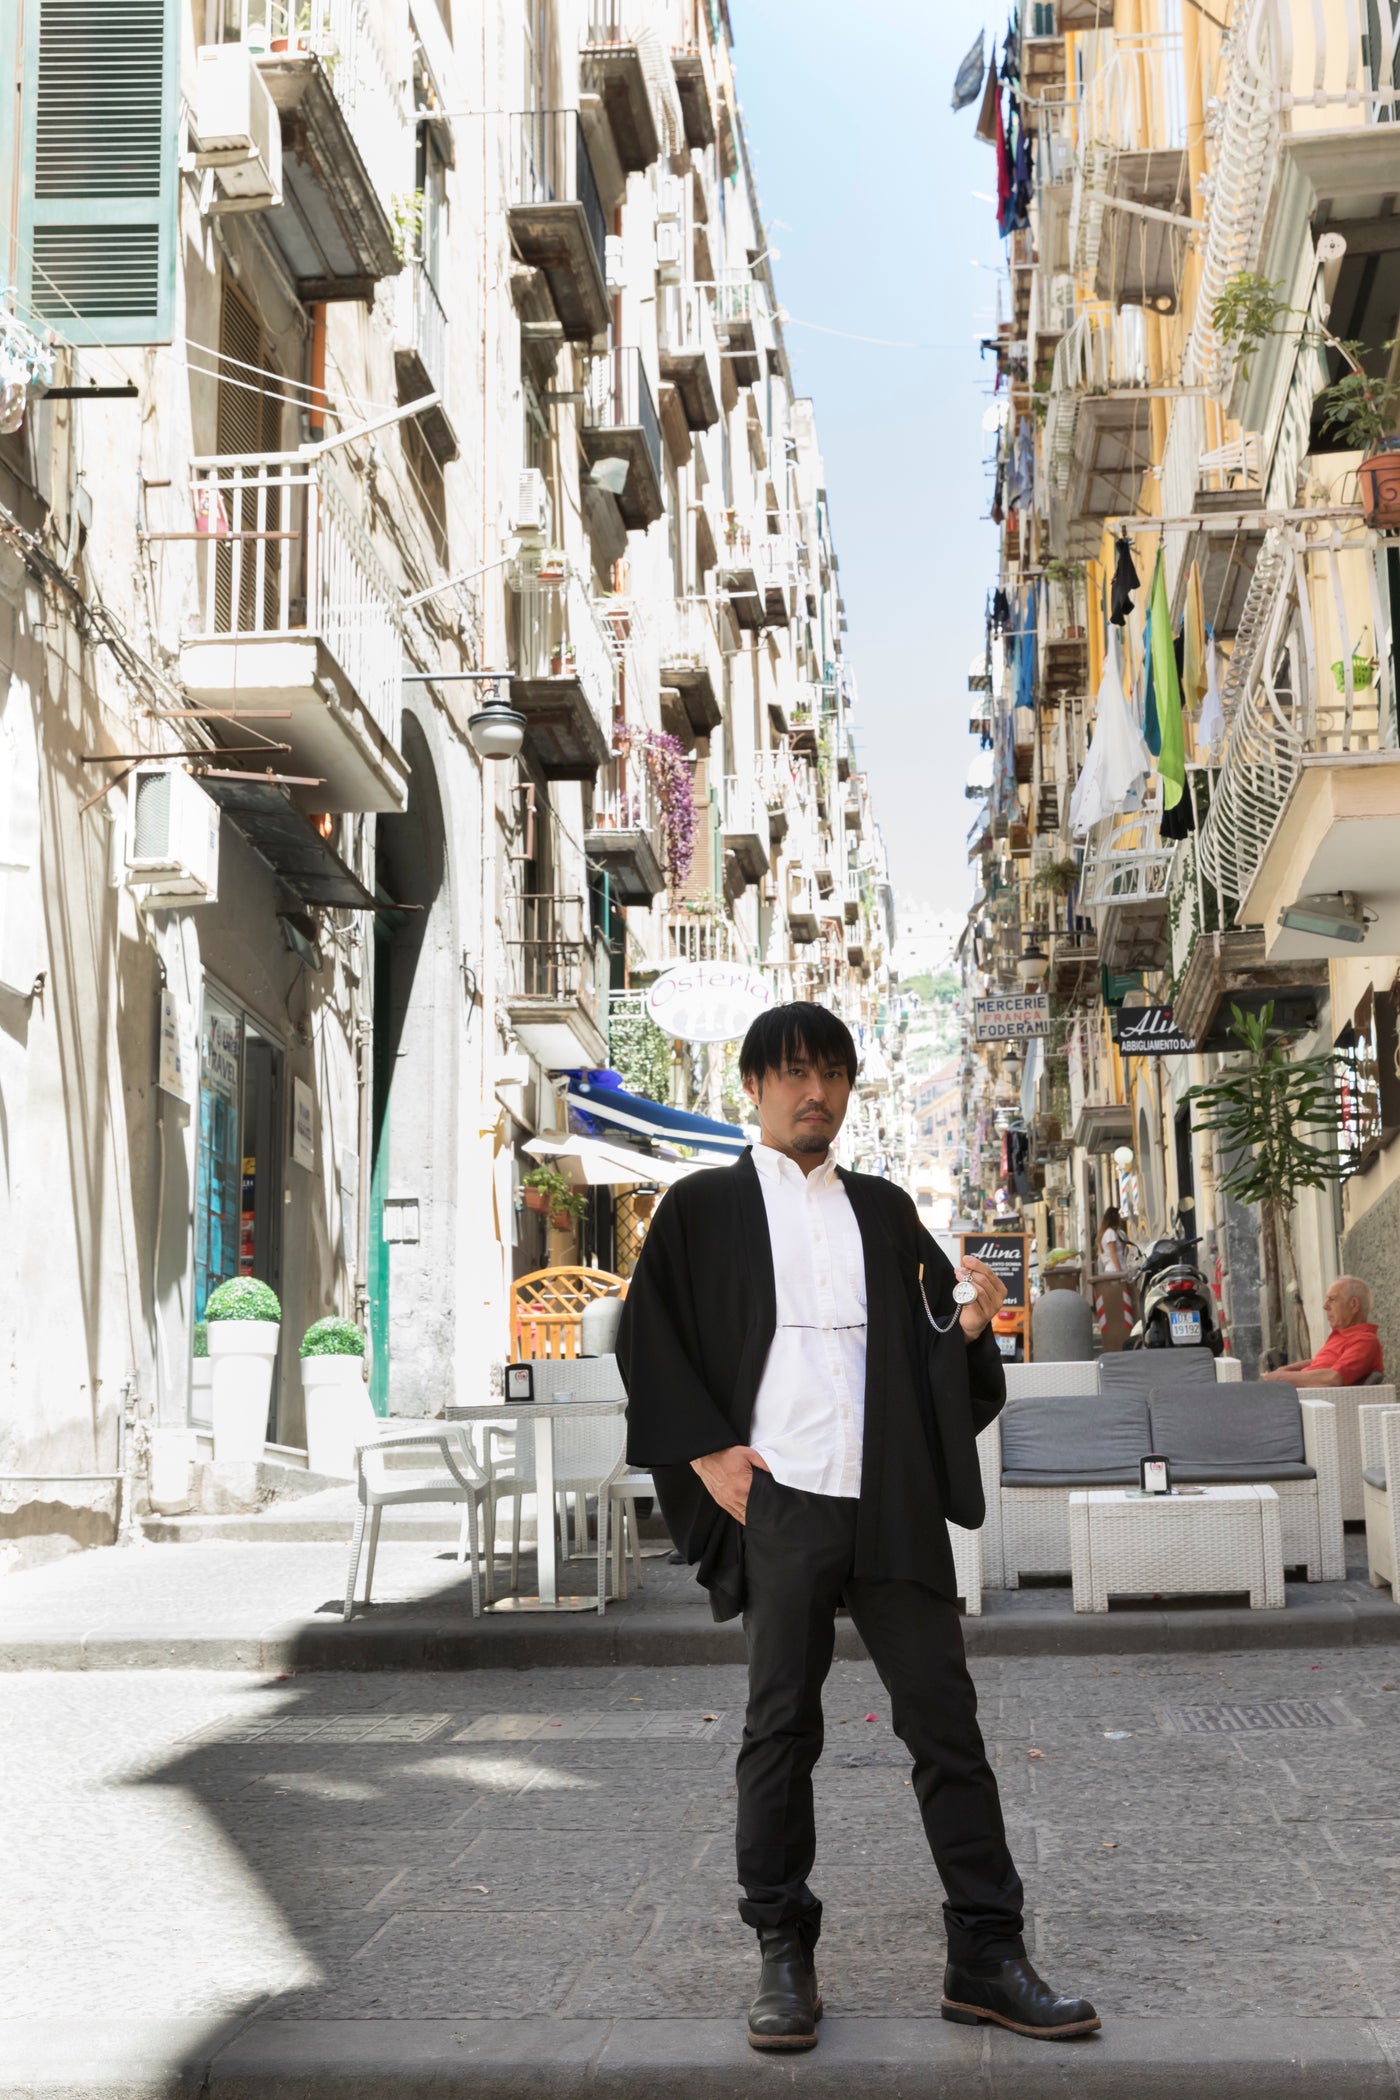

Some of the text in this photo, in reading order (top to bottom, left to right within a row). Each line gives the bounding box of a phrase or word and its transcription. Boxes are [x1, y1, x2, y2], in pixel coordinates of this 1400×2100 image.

[650, 967, 769, 1007] Osteria
[977, 996, 1046, 1013] MERCERIE
[979, 1020, 1048, 1037] FODERAMI
[1119, 1009, 1184, 1038] Ali
[1121, 1038, 1179, 1051] ABBIGLIAMENTO
[208, 1047, 236, 1085] TRAVEL
[971, 1242, 1022, 1259] Alina
[1174, 1325, 1200, 1335] 19192
